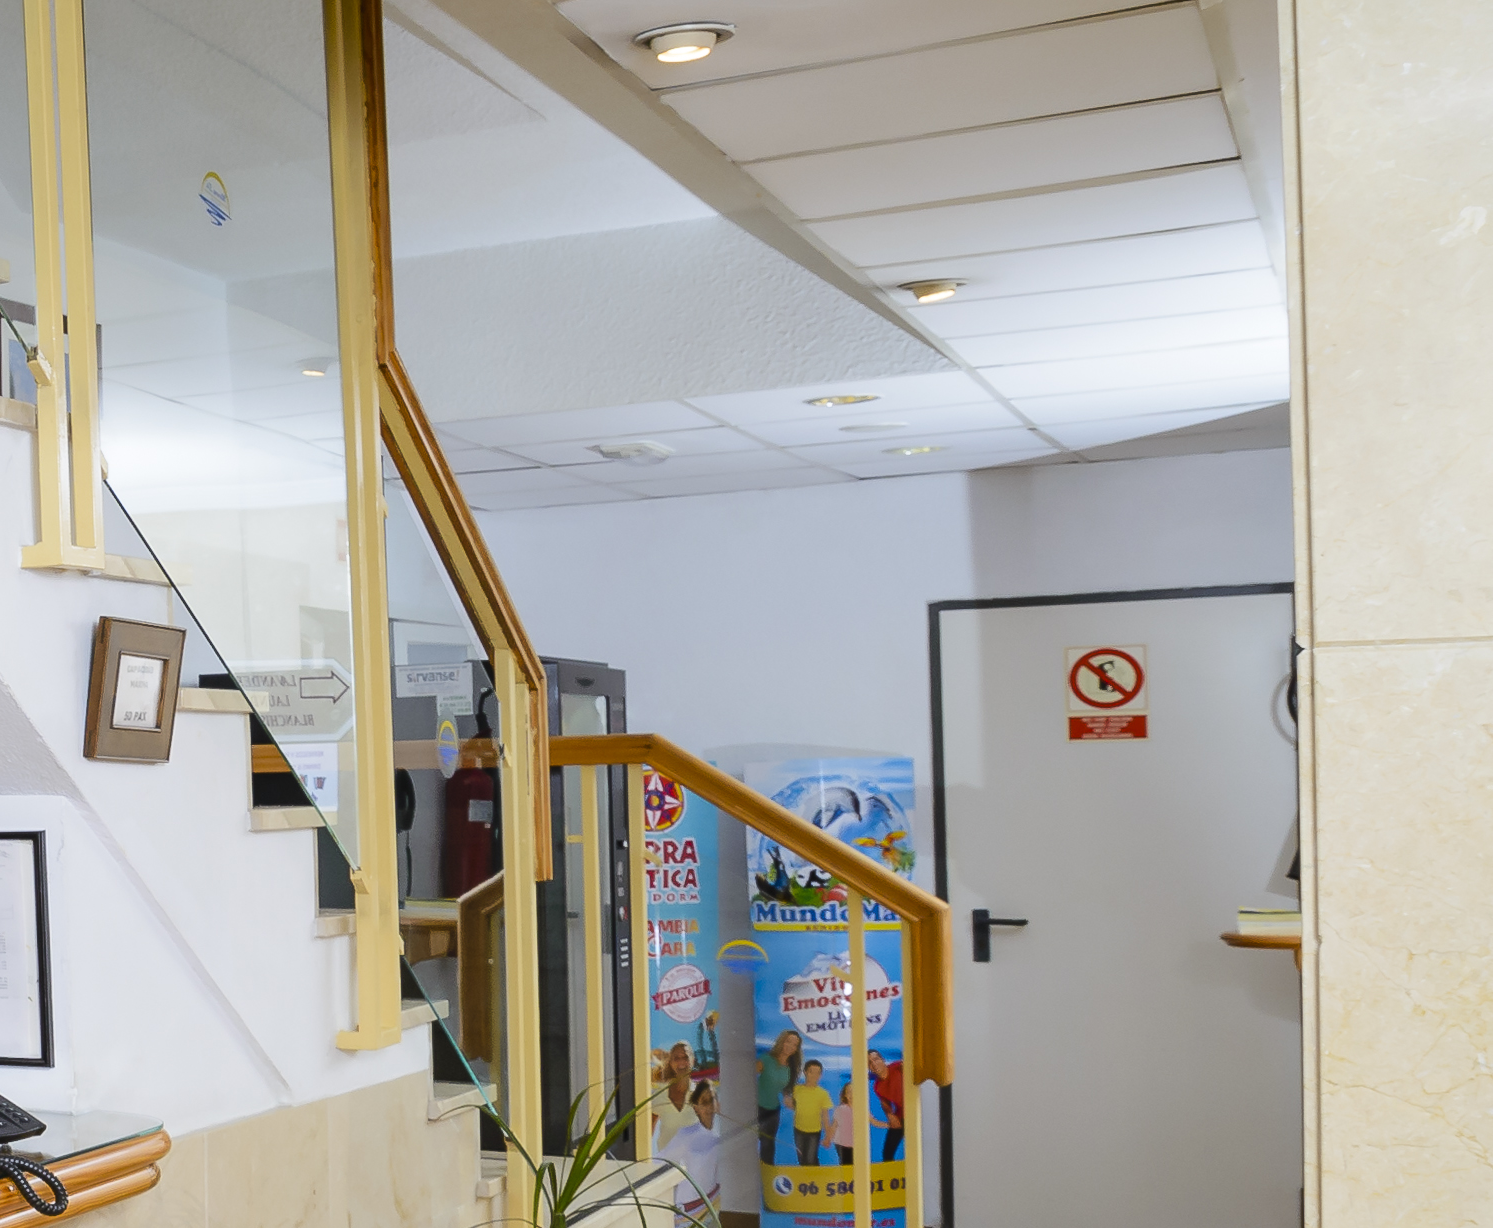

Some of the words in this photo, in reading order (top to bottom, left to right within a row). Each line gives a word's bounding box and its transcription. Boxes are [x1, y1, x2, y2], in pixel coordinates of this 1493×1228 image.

[134, 711, 147, 721] PAX
[646, 869, 698, 888] TICA
[653, 893, 700, 901] DORM
[783, 985, 900, 1012] Emocnes
[806, 1014, 882, 1032] EMOTNS
[798, 1182, 819, 1197] 96
